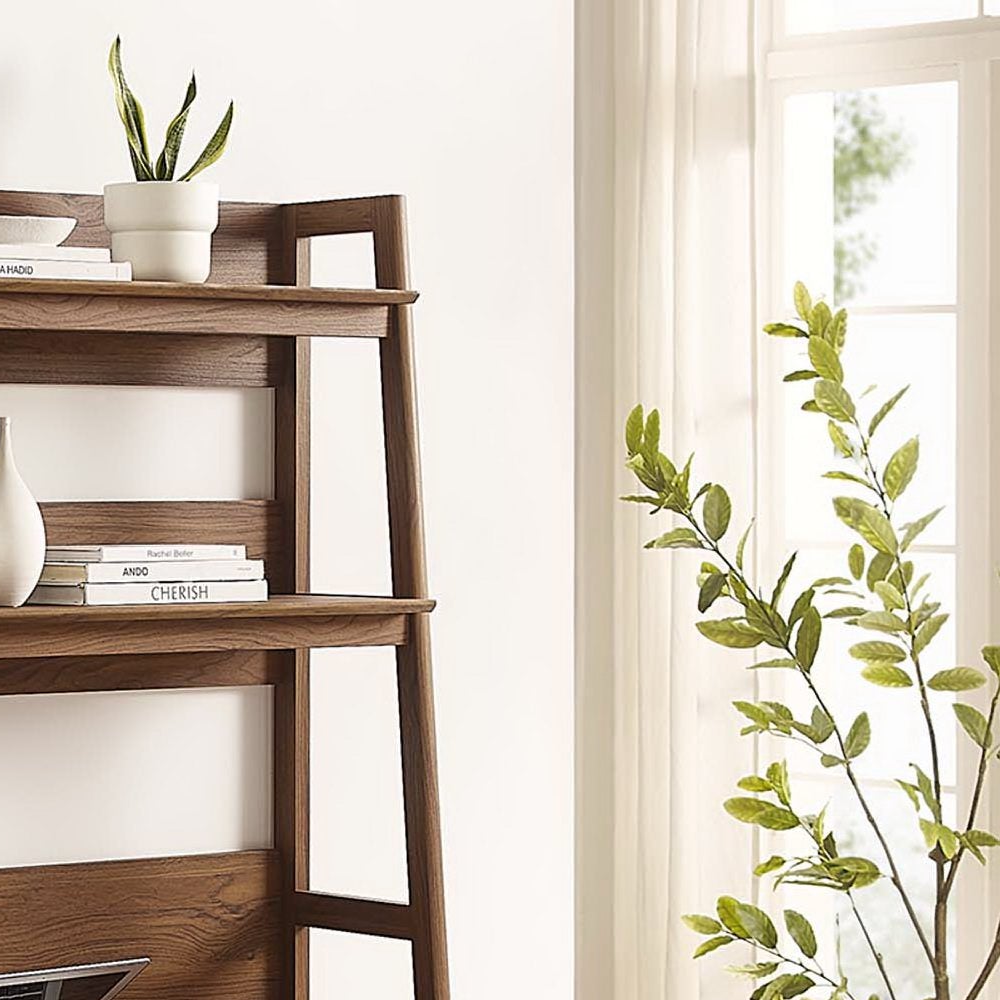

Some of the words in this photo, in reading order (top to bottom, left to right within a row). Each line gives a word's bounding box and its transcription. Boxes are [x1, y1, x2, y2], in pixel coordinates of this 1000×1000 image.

[7, 265, 34, 275] HADID
[122, 567, 149, 576] ANDO
[151, 586, 209, 600] CHERISH
